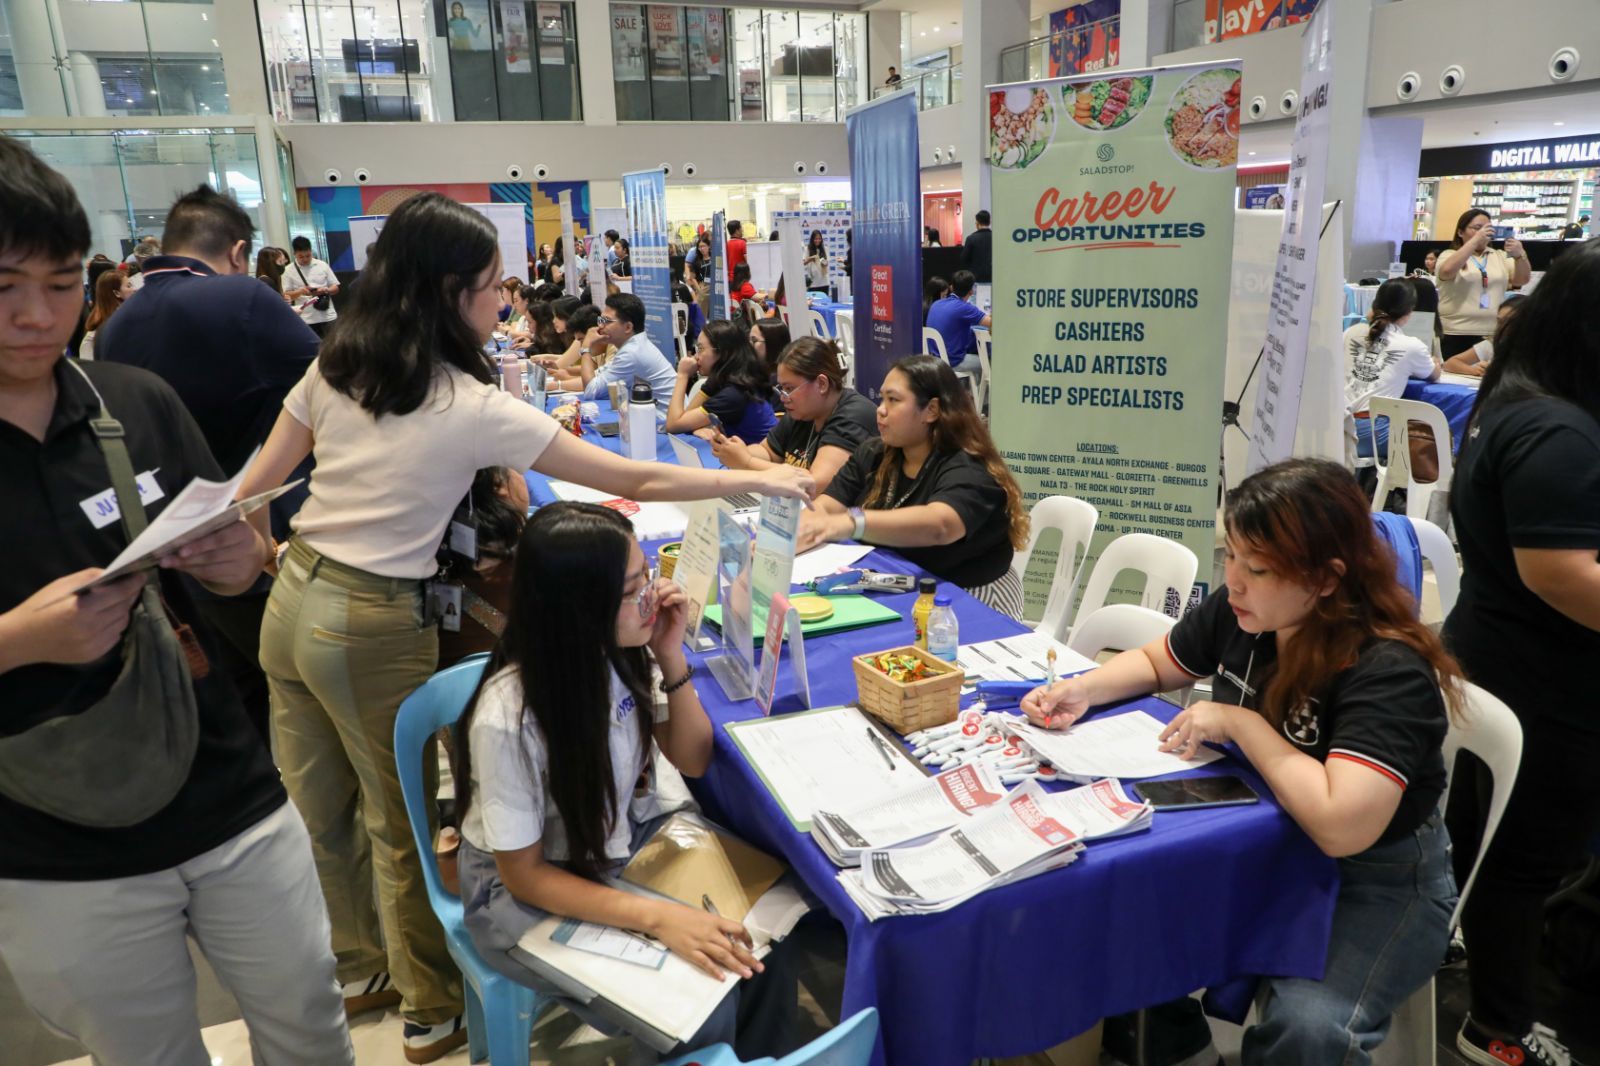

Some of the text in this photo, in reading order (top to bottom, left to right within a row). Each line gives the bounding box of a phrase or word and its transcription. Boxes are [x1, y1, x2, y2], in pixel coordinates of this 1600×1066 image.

[614, 18, 637, 30] SALE
[1085, 50, 1118, 72] Reay
[1491, 145, 1551, 168] DIGITAL
[1079, 164, 1135, 176] SALADSTOP!
[1034, 180, 1176, 231] Career
[1012, 222, 1206, 243] OPPORTUNITIES
[872, 269, 888, 281] Great
[872, 281, 888, 292] Place
[872, 293, 879, 303] To
[1016, 288, 1199, 309] STORE SUPERVISORS
[1055, 321, 1145, 342] CASHIERS
[1033, 353, 1168, 376] SALAD ARTISTS
[1021, 384, 1185, 411] PREP SPECIALISTS
[1076, 442, 1119, 454] LOCATIONS:
[1027, 453, 1048, 462] TOWN
[1048, 454, 1076, 464] CENTER
[1081, 457, 1104, 466] AYALA
[1105, 458, 1130, 467] NORTH
[1131, 459, 1169, 470] EXCHANGE
[1175, 463, 1207, 473] BURGOS
[1023, 465, 1051, 476] SQUARE
[1056, 467, 1090, 477] GATEWAY
[1090, 470, 1110, 480] MALL
[1115, 472, 1156, 482] GLORIETTA
[1162, 475, 1209, 487] GREENHILLS
[1040, 480, 1156, 496] NAIA T3 THE ROCK HOLY SPIRIT
[1130, 500, 1142, 508] SM
[1143, 502, 1162, 510] MALL
[1163, 502, 1173, 511] OF
[1174, 504, 1193, 513] ASIA
[1109, 511, 1148, 523] ROCKWELL
[1148, 515, 1185, 526] BUSINESS
[1186, 519, 1216, 528] CENTER
[1121, 526, 1131, 534] UP
[1155, 529, 1183, 540] CENTER
